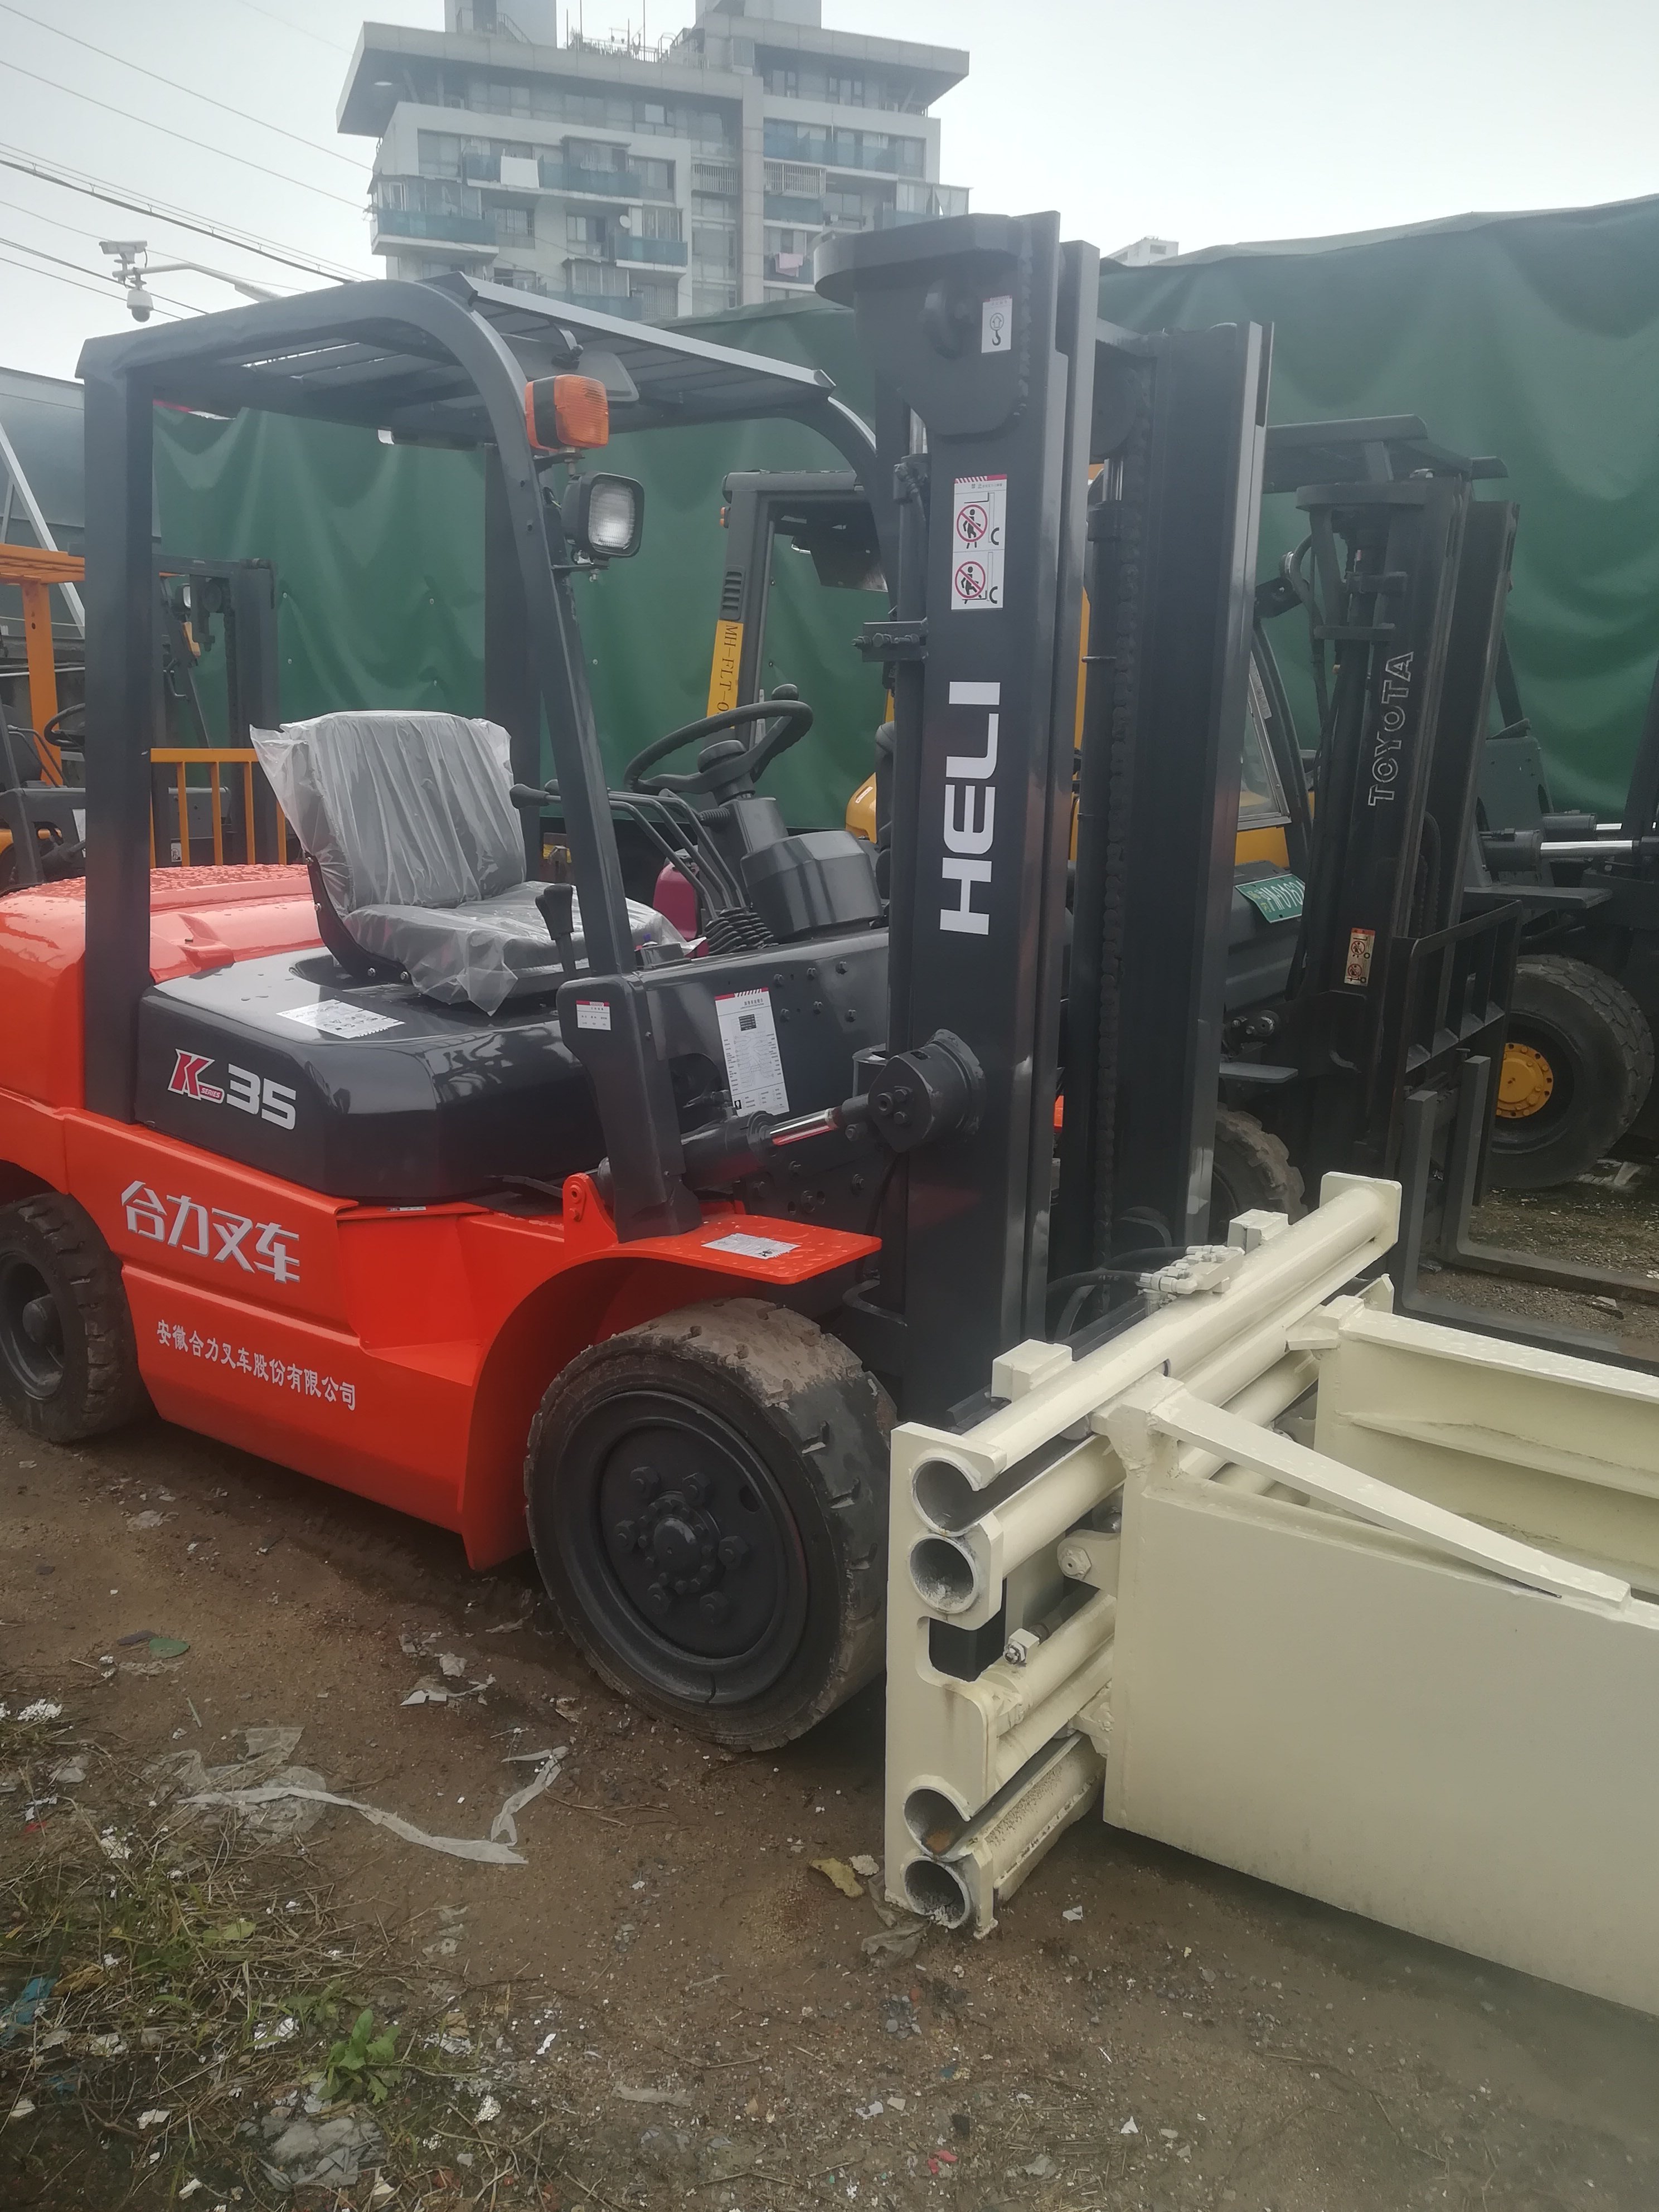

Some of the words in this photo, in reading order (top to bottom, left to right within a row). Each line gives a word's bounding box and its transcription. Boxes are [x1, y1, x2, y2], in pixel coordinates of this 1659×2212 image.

[717, 625, 738, 714] MH-FLT-0
[1367, 651, 1414, 806] TOYOTA
[939, 681, 1001, 935] HELI
[168, 1048, 215, 1100] K
[201, 1088, 221, 1098] SERIES
[226, 1064, 297, 1130] 35
[121, 1180, 300, 1284] 合力叉车
[157, 1320, 356, 1411] 安徽合力叉车股份有限公司
